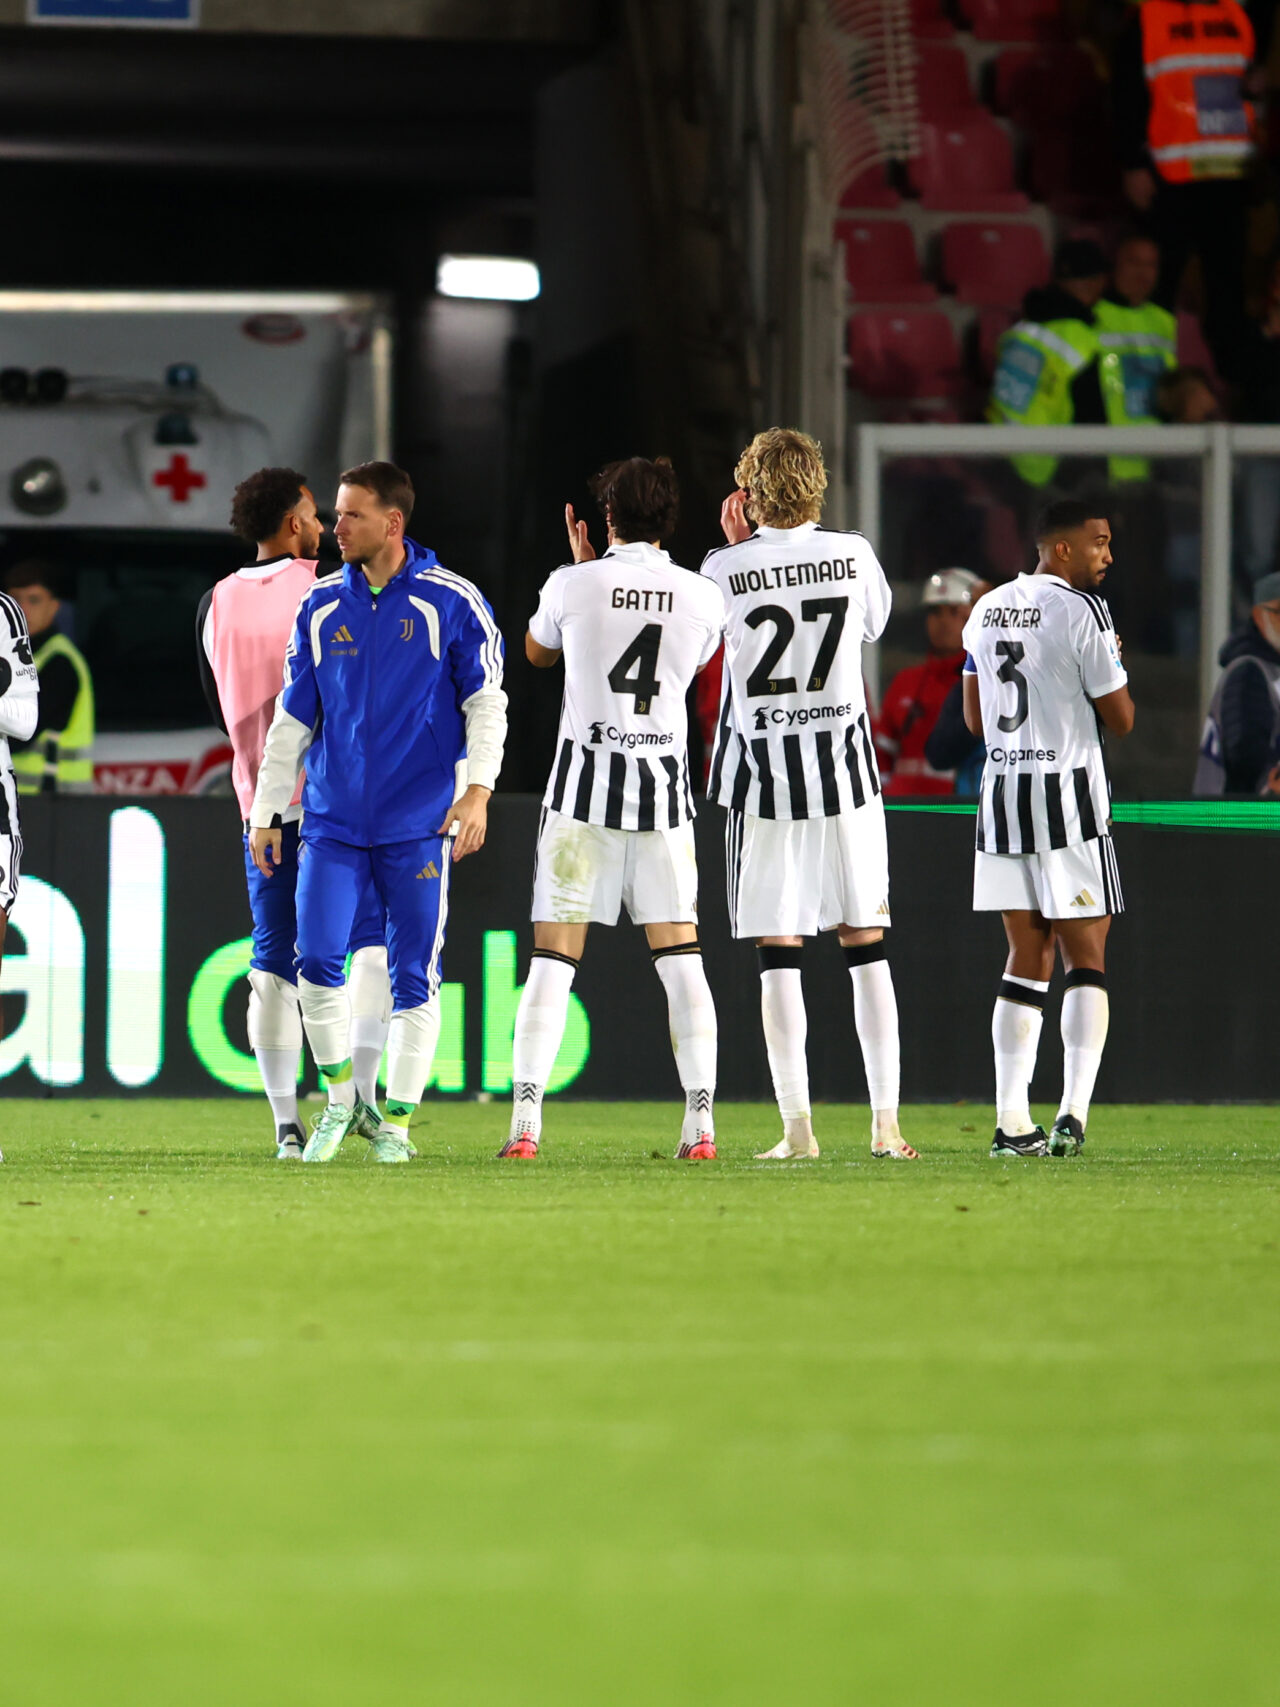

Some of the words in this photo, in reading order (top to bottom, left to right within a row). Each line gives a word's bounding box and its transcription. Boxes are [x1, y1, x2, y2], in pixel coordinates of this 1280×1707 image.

[729, 557, 857, 596] WOLTEMADE
[612, 587, 673, 613] GATTI
[744, 596, 849, 698] 27
[608, 623, 663, 716] 4
[995, 640, 1029, 733] 3
[771, 703, 852, 726] Cygames
[607, 726, 673, 749] Cygames
